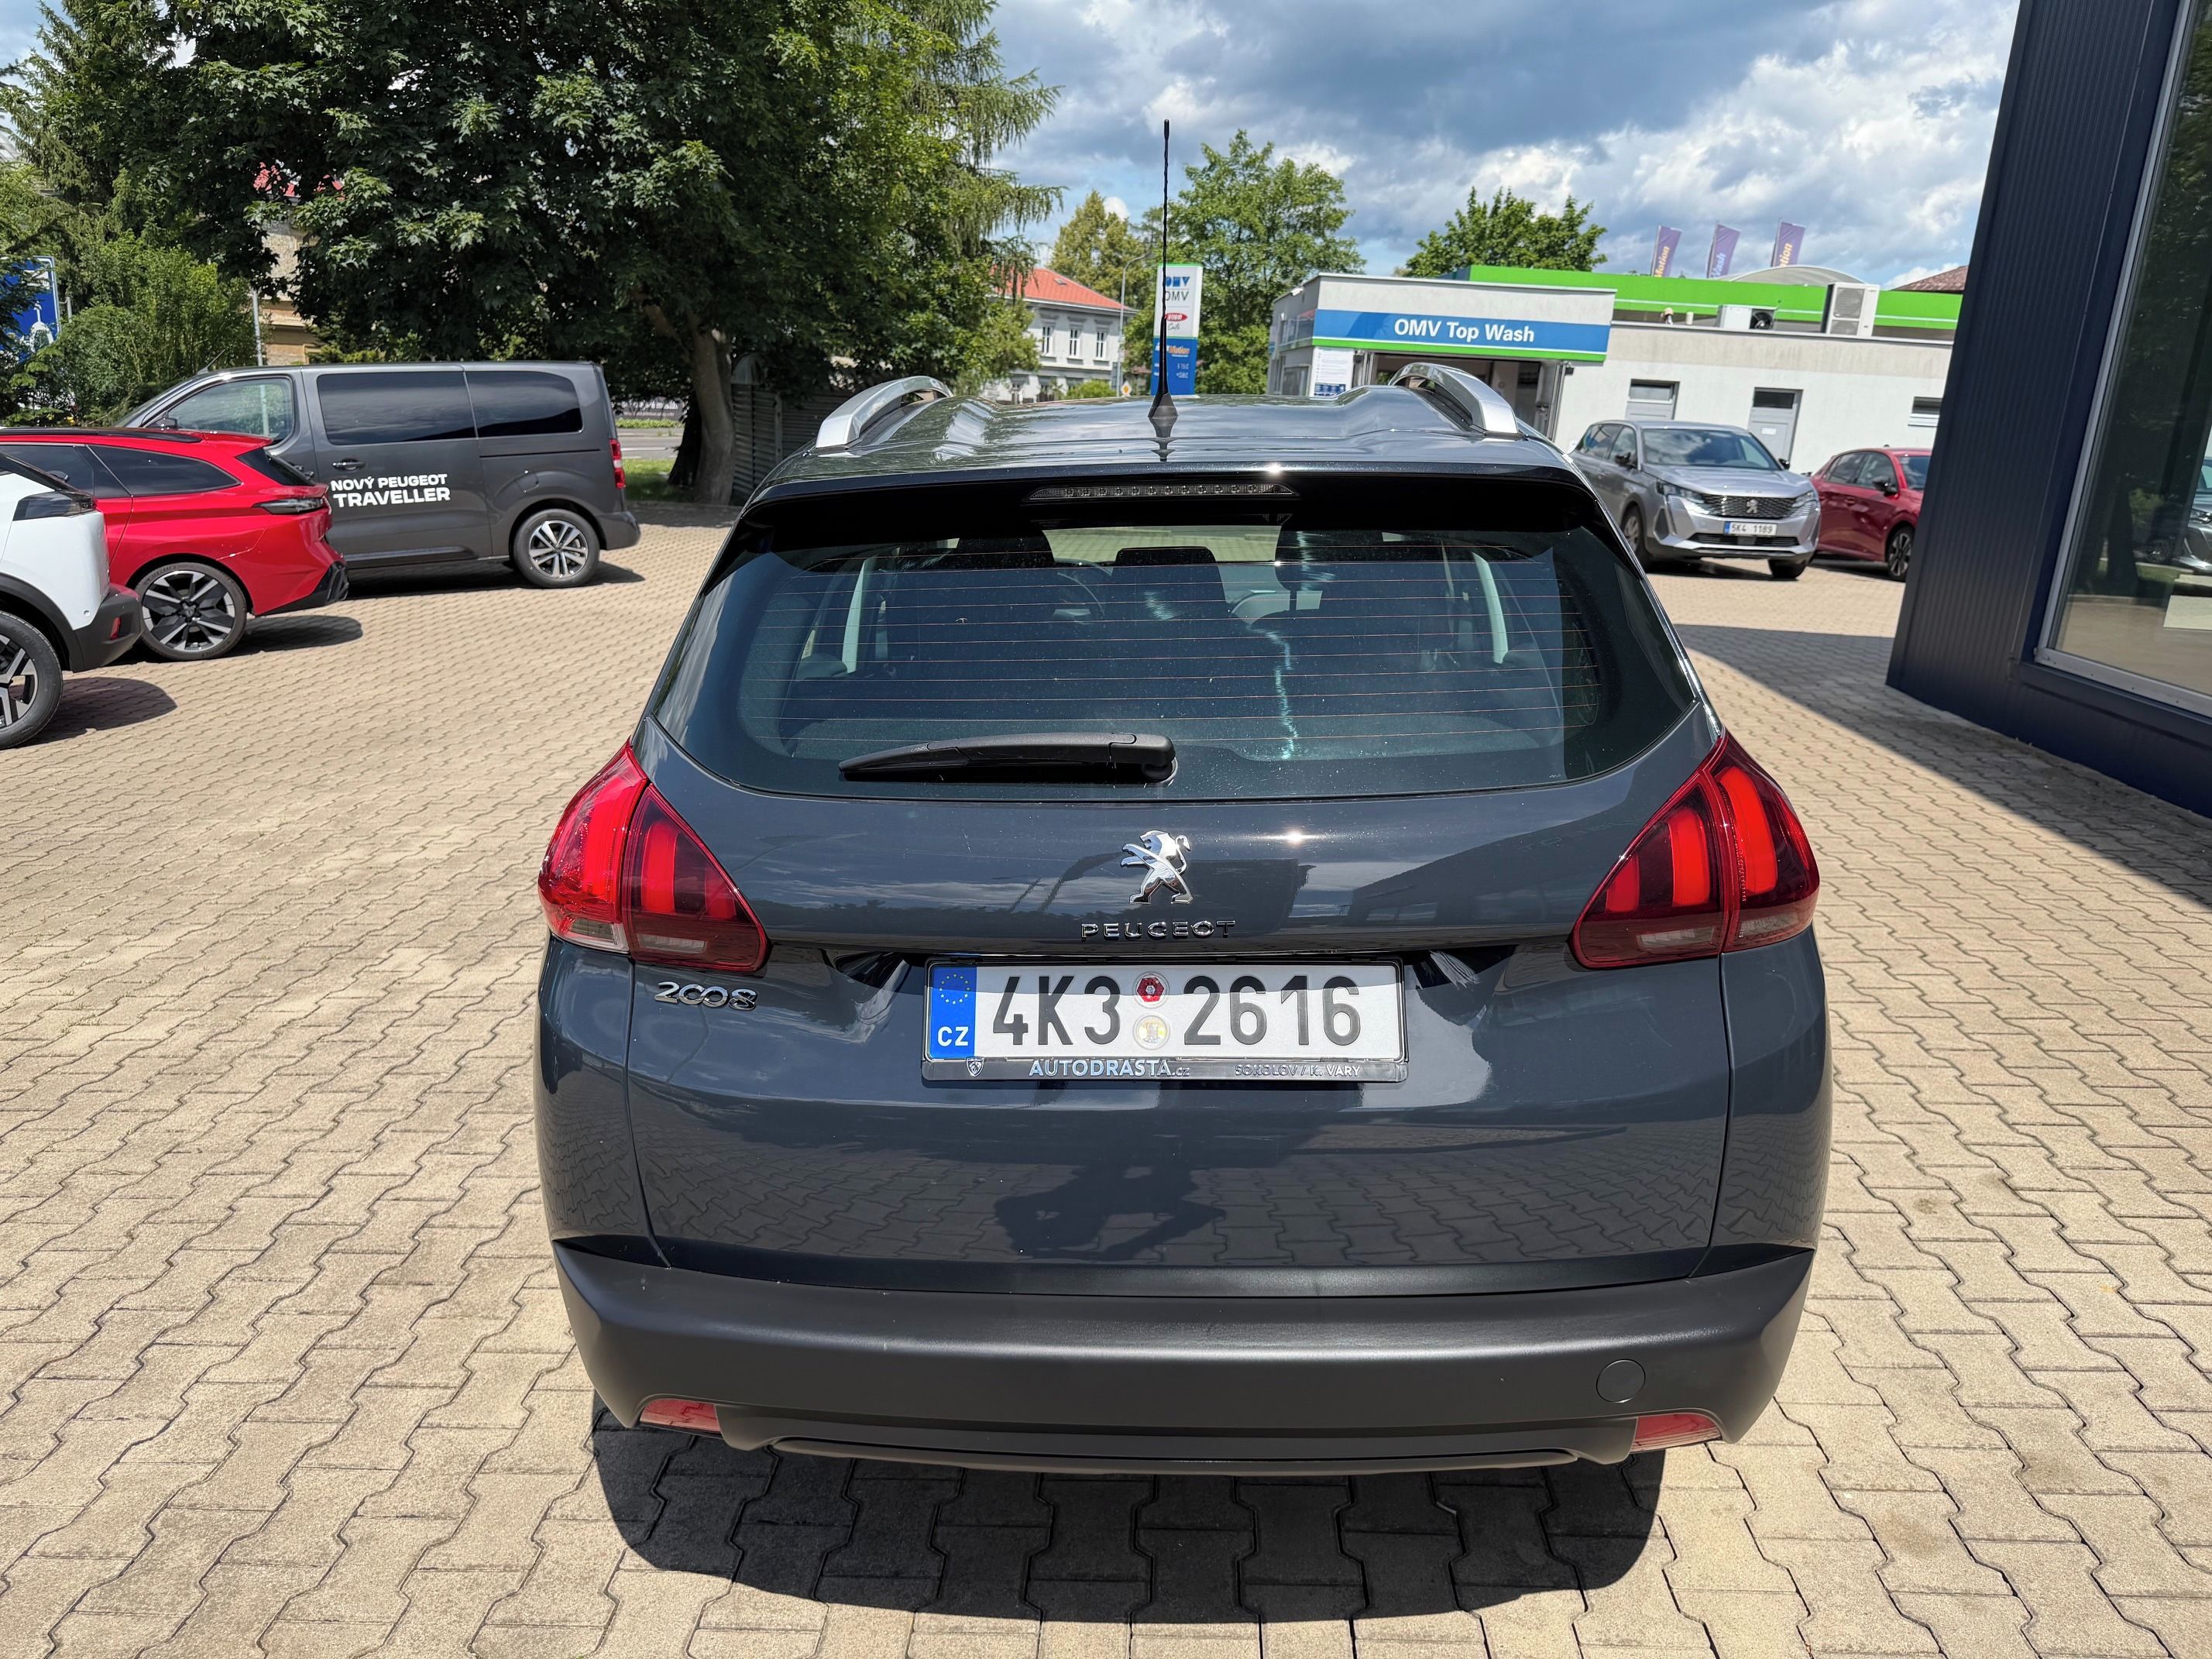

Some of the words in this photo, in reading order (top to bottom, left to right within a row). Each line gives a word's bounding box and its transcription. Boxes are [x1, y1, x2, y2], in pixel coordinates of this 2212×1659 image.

[1394, 318, 1441, 337] OMV
[1446, 321, 1479, 342] Top
[1485, 324, 1534, 342] Wash
[331, 476, 375, 491] NOVÝ
[377, 473, 448, 489] PEUGEOT
[333, 487, 451, 508] TRAVELLER
[1081, 920, 1236, 941] PEUGEOT
[654, 981, 758, 1012] 2008
[992, 975, 1121, 1046] 4K3
[1183, 974, 1361, 1046] 2616
[936, 1025, 970, 1047] CZ
[1234, 1063, 1297, 1077] SOKOLOV
[1325, 1065, 1362, 1077] VARY
